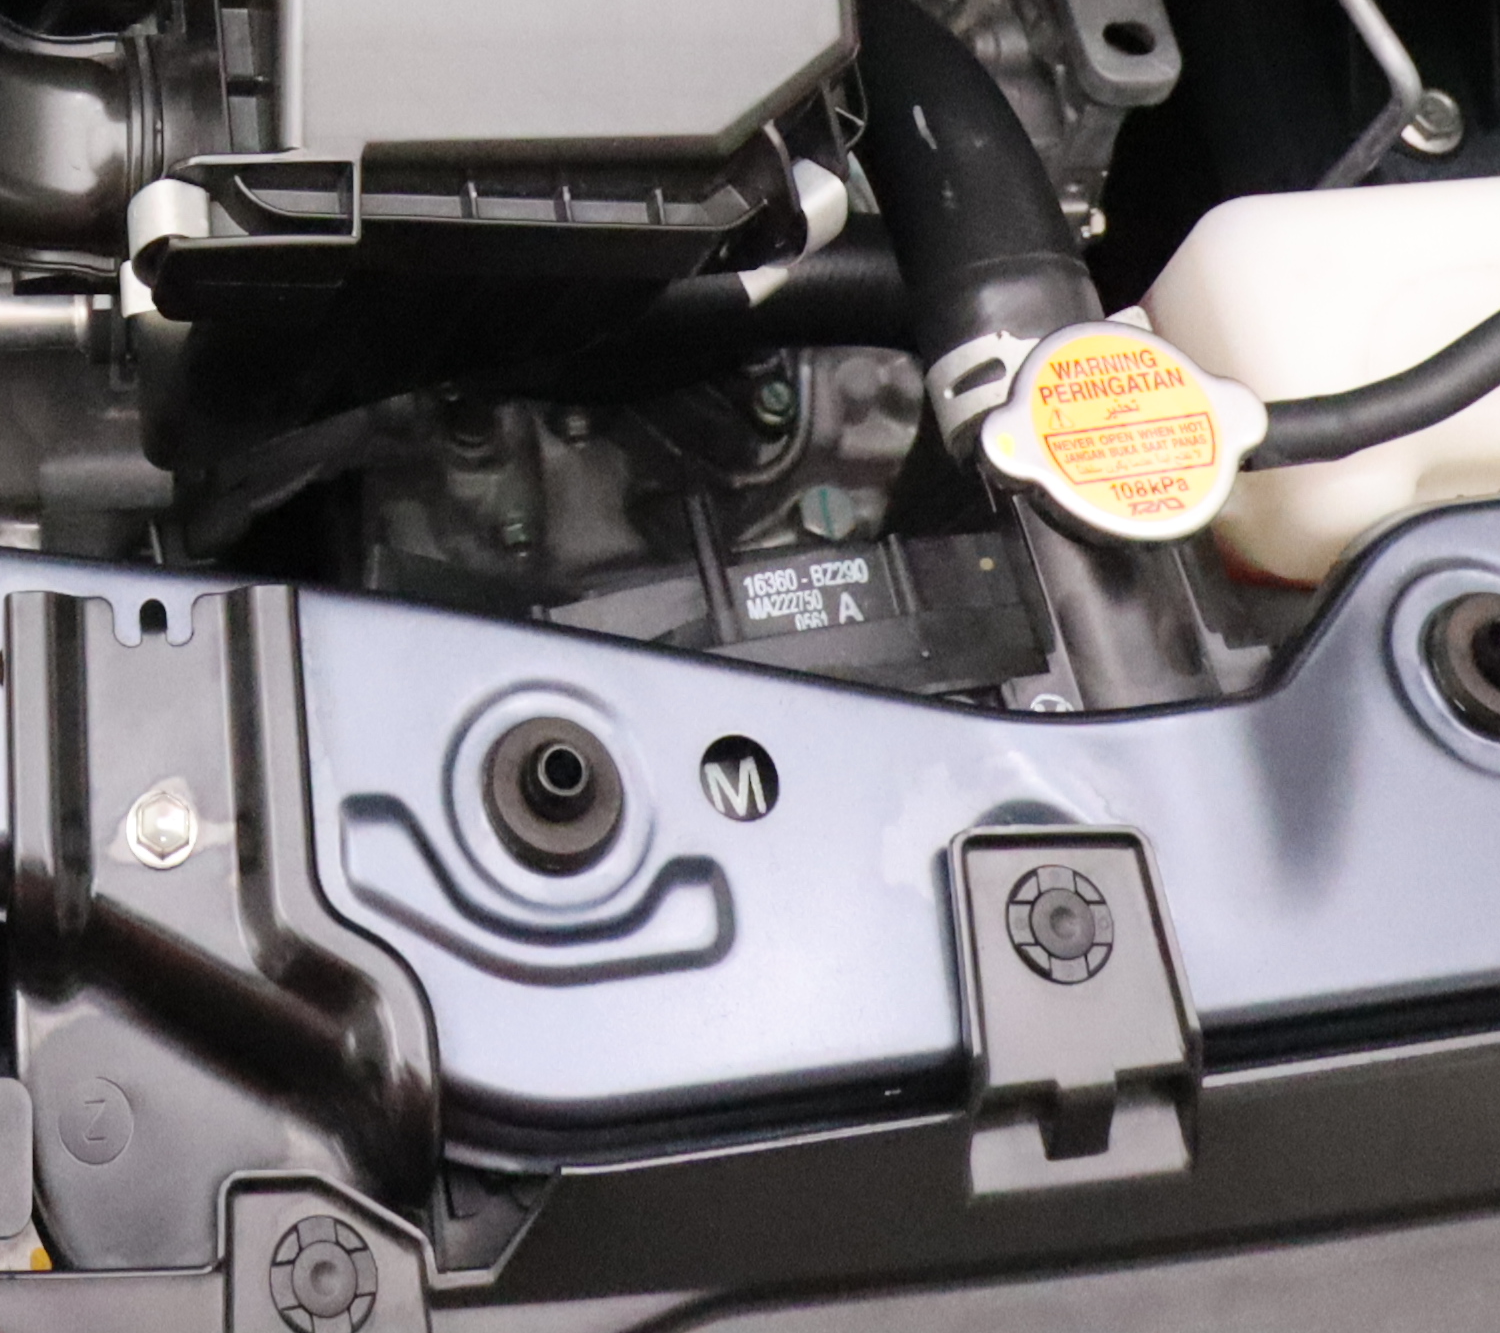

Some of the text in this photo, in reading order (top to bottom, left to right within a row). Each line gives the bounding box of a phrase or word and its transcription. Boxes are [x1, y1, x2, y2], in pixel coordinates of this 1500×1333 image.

[1050, 349, 1158, 380] WARNING
[1039, 368, 1185, 405] PERINGATAN
[1053, 437, 1095, 452] NEVER
[1099, 432, 1133, 447] OPEN
[1139, 426, 1174, 440] WHEN
[1064, 449, 1106, 463] JANGAN
[1109, 444, 1138, 457] BUKA
[1143, 439, 1168, 452] SAAT
[1172, 435, 1207, 449] PANAS
[839, 592, 865, 625] A
[704, 756, 767, 817] M
